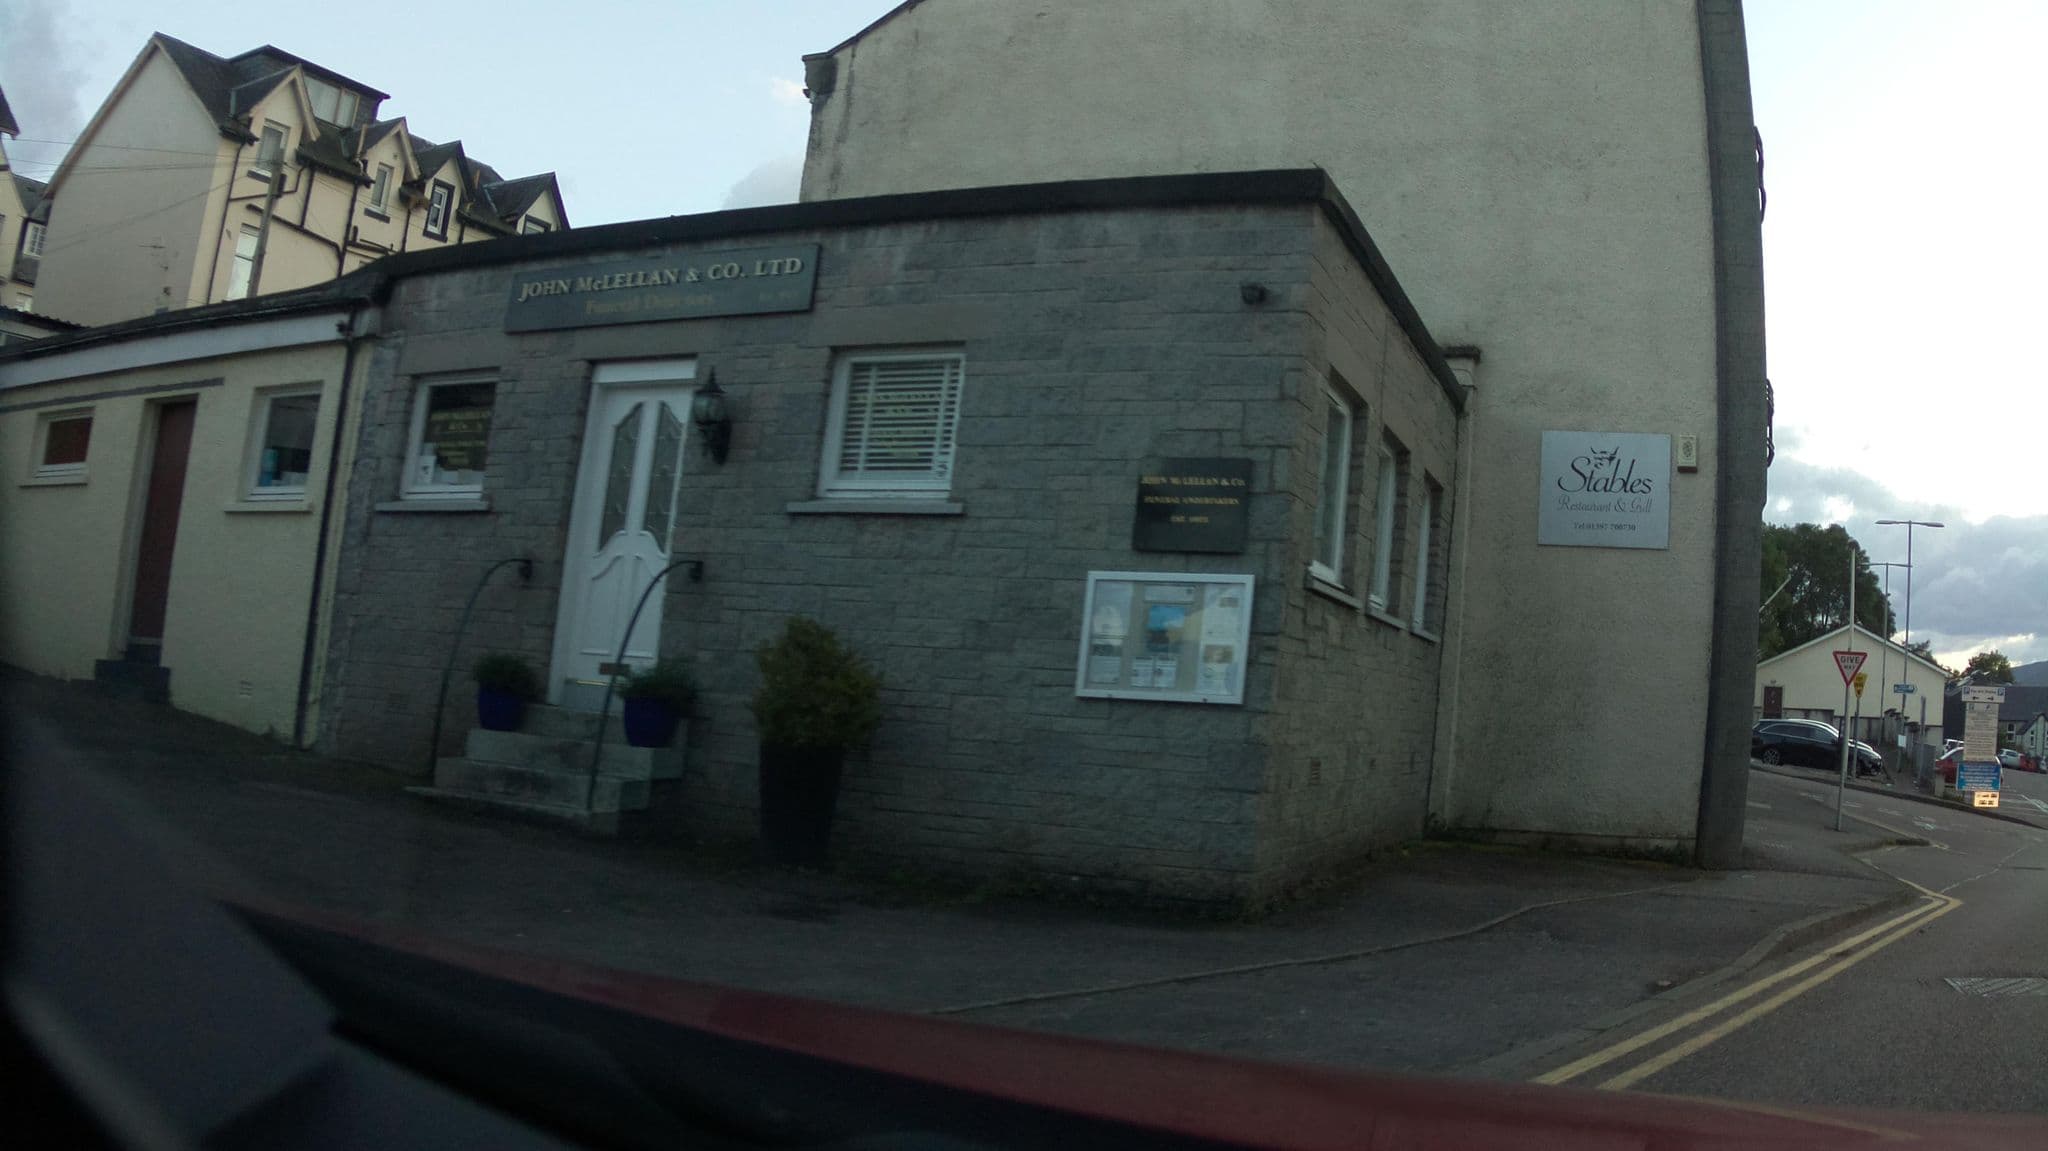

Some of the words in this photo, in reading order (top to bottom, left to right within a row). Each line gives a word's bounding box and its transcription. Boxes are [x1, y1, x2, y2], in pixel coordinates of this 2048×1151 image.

[517, 279, 572, 302] JOHN
[575, 268, 680, 291] McLELLAN
[685, 267, 699, 283] &
[707, 262, 747, 280] CO.
[754, 257, 802, 275] LTD
[1557, 455, 1653, 495] Stables
[1557, 495, 1611, 512] Restaurant
[1614, 497, 1628, 513] &
[1628, 497, 1653, 514] Grill
[1840, 656, 1860, 664] GIVE
